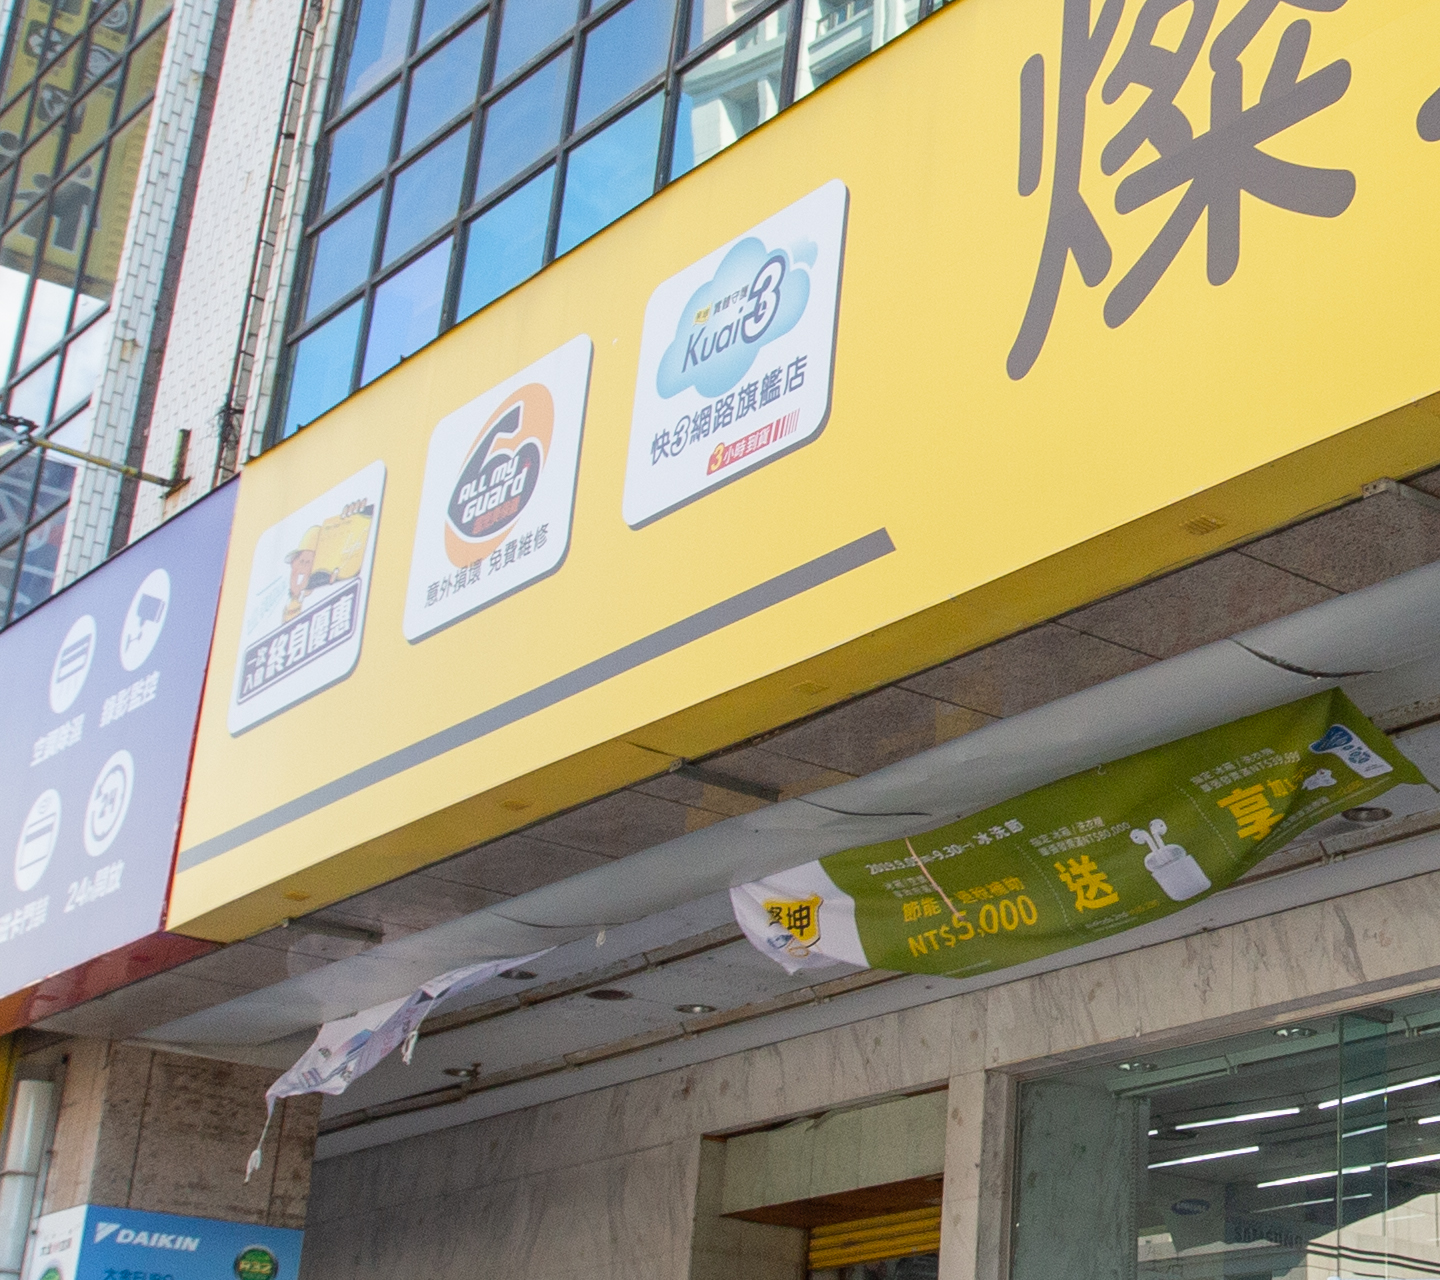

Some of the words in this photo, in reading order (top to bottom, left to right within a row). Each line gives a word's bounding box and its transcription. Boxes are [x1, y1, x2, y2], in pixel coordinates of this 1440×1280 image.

[425, 558, 482, 608] 意外損壞
[488, 523, 549, 576] 免費維修
[265, 593, 354, 679] 終身優惠
[1217, 783, 1285, 841] 享
[1054, 854, 1119, 913] 送
[116, 1229, 201, 1252] DAIKIN
